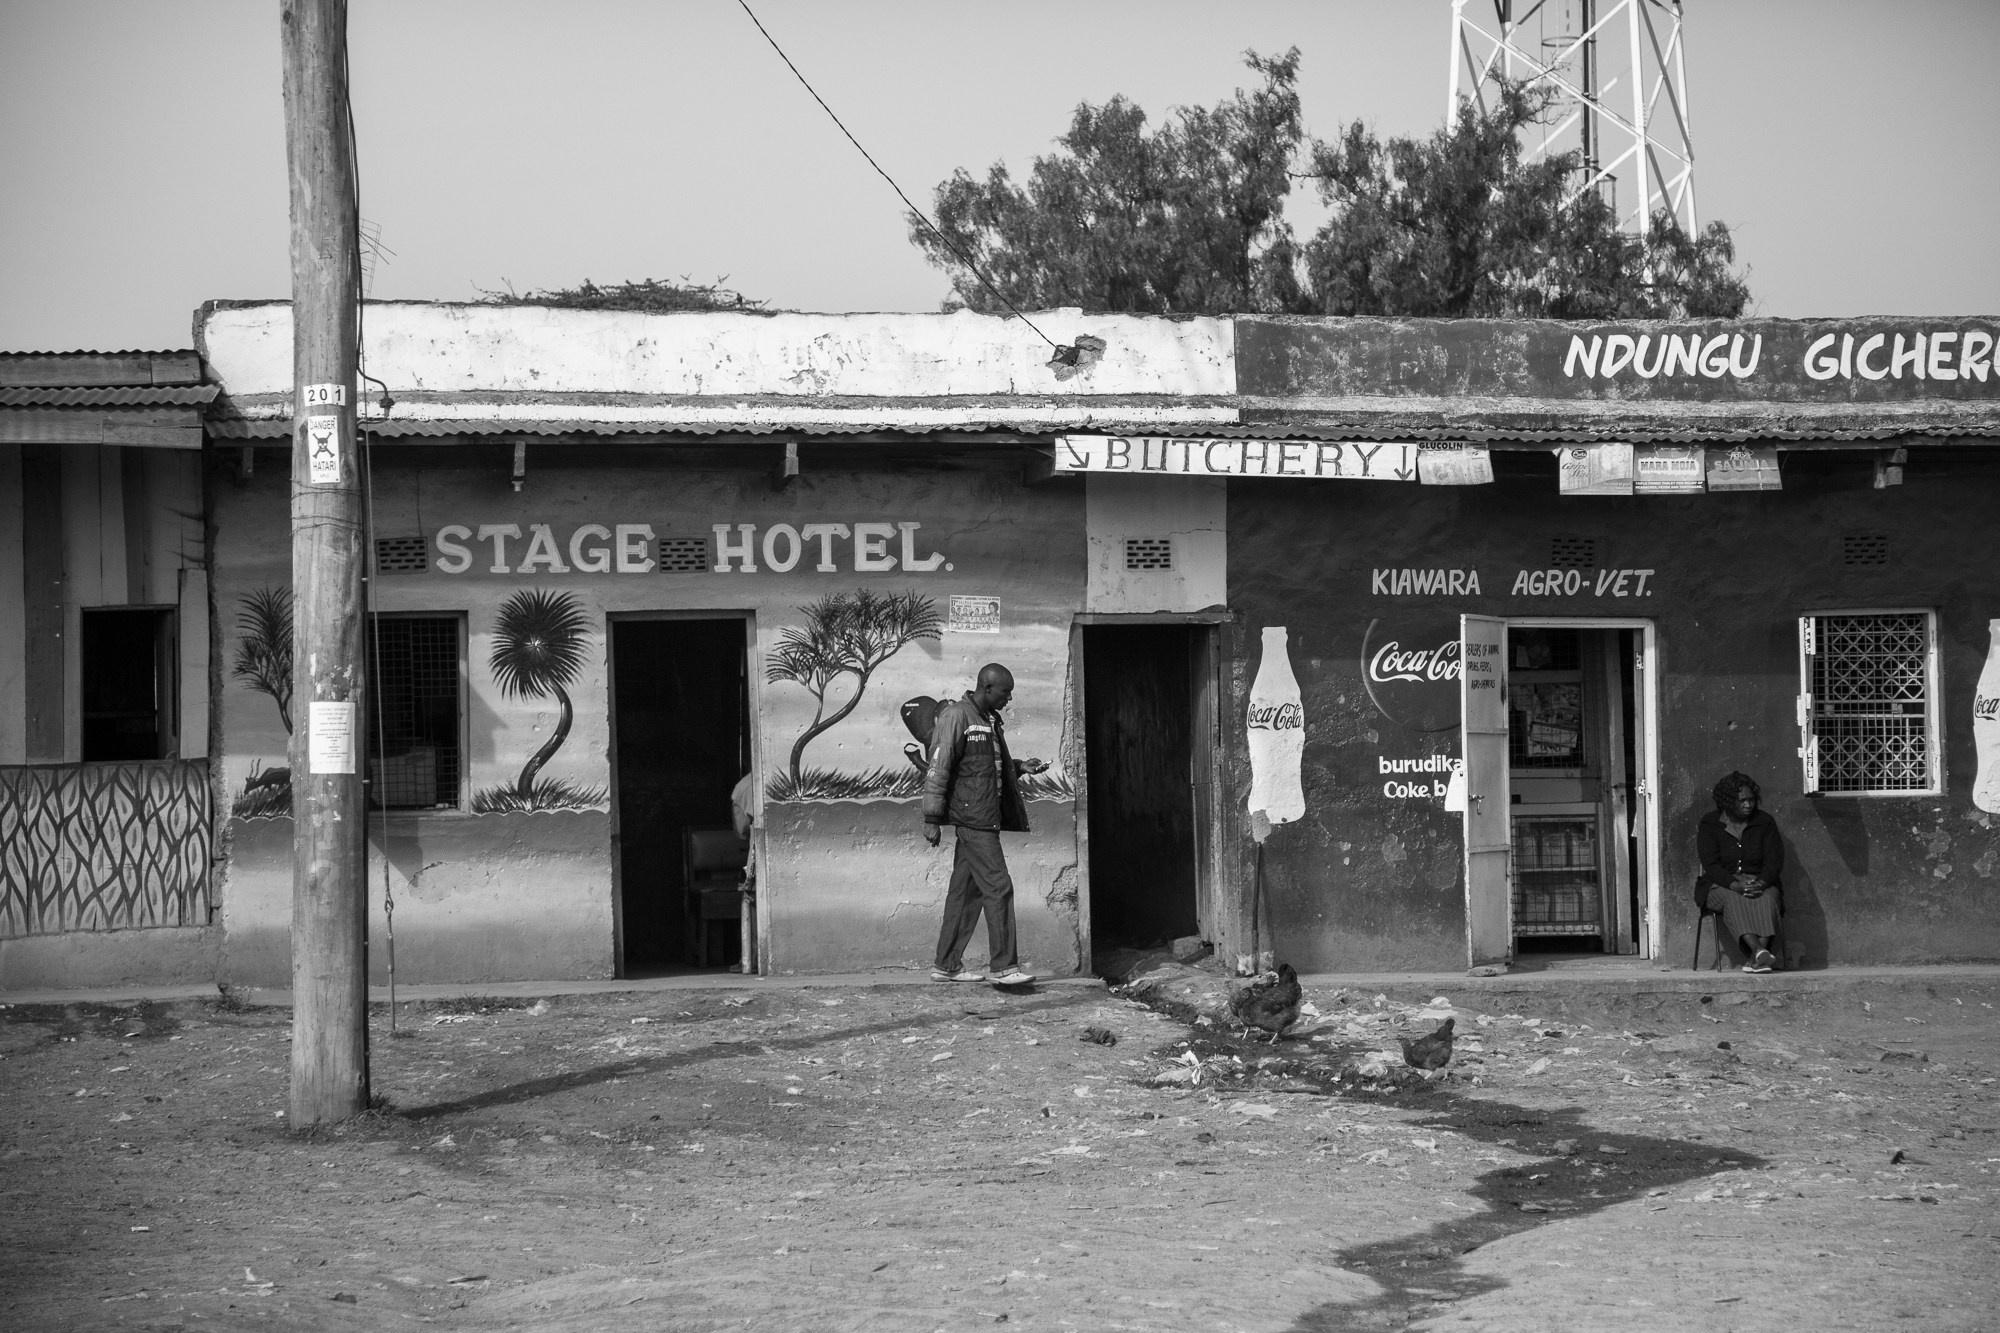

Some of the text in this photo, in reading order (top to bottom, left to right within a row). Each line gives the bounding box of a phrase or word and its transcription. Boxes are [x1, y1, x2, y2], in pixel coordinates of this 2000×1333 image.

[1563, 331, 2000, 382] NDUNGU GICHER
[308, 388, 341, 402] 201
[309, 419, 336, 430] DANGER
[1105, 438, 1383, 477] BUTCHERY
[1418, 442, 1463, 450] GLUCOLIN
[313, 460, 337, 471] HATARI
[1641, 460, 1697, 471] MARA MOJA
[435, 521, 954, 574] STAGE HOTEL.
[1372, 569, 1655, 597] KIAWARA AGRO-VET.
[1369, 641, 1461, 682] Coca-Co
[1248, 702, 1302, 731] Coca-Cola
